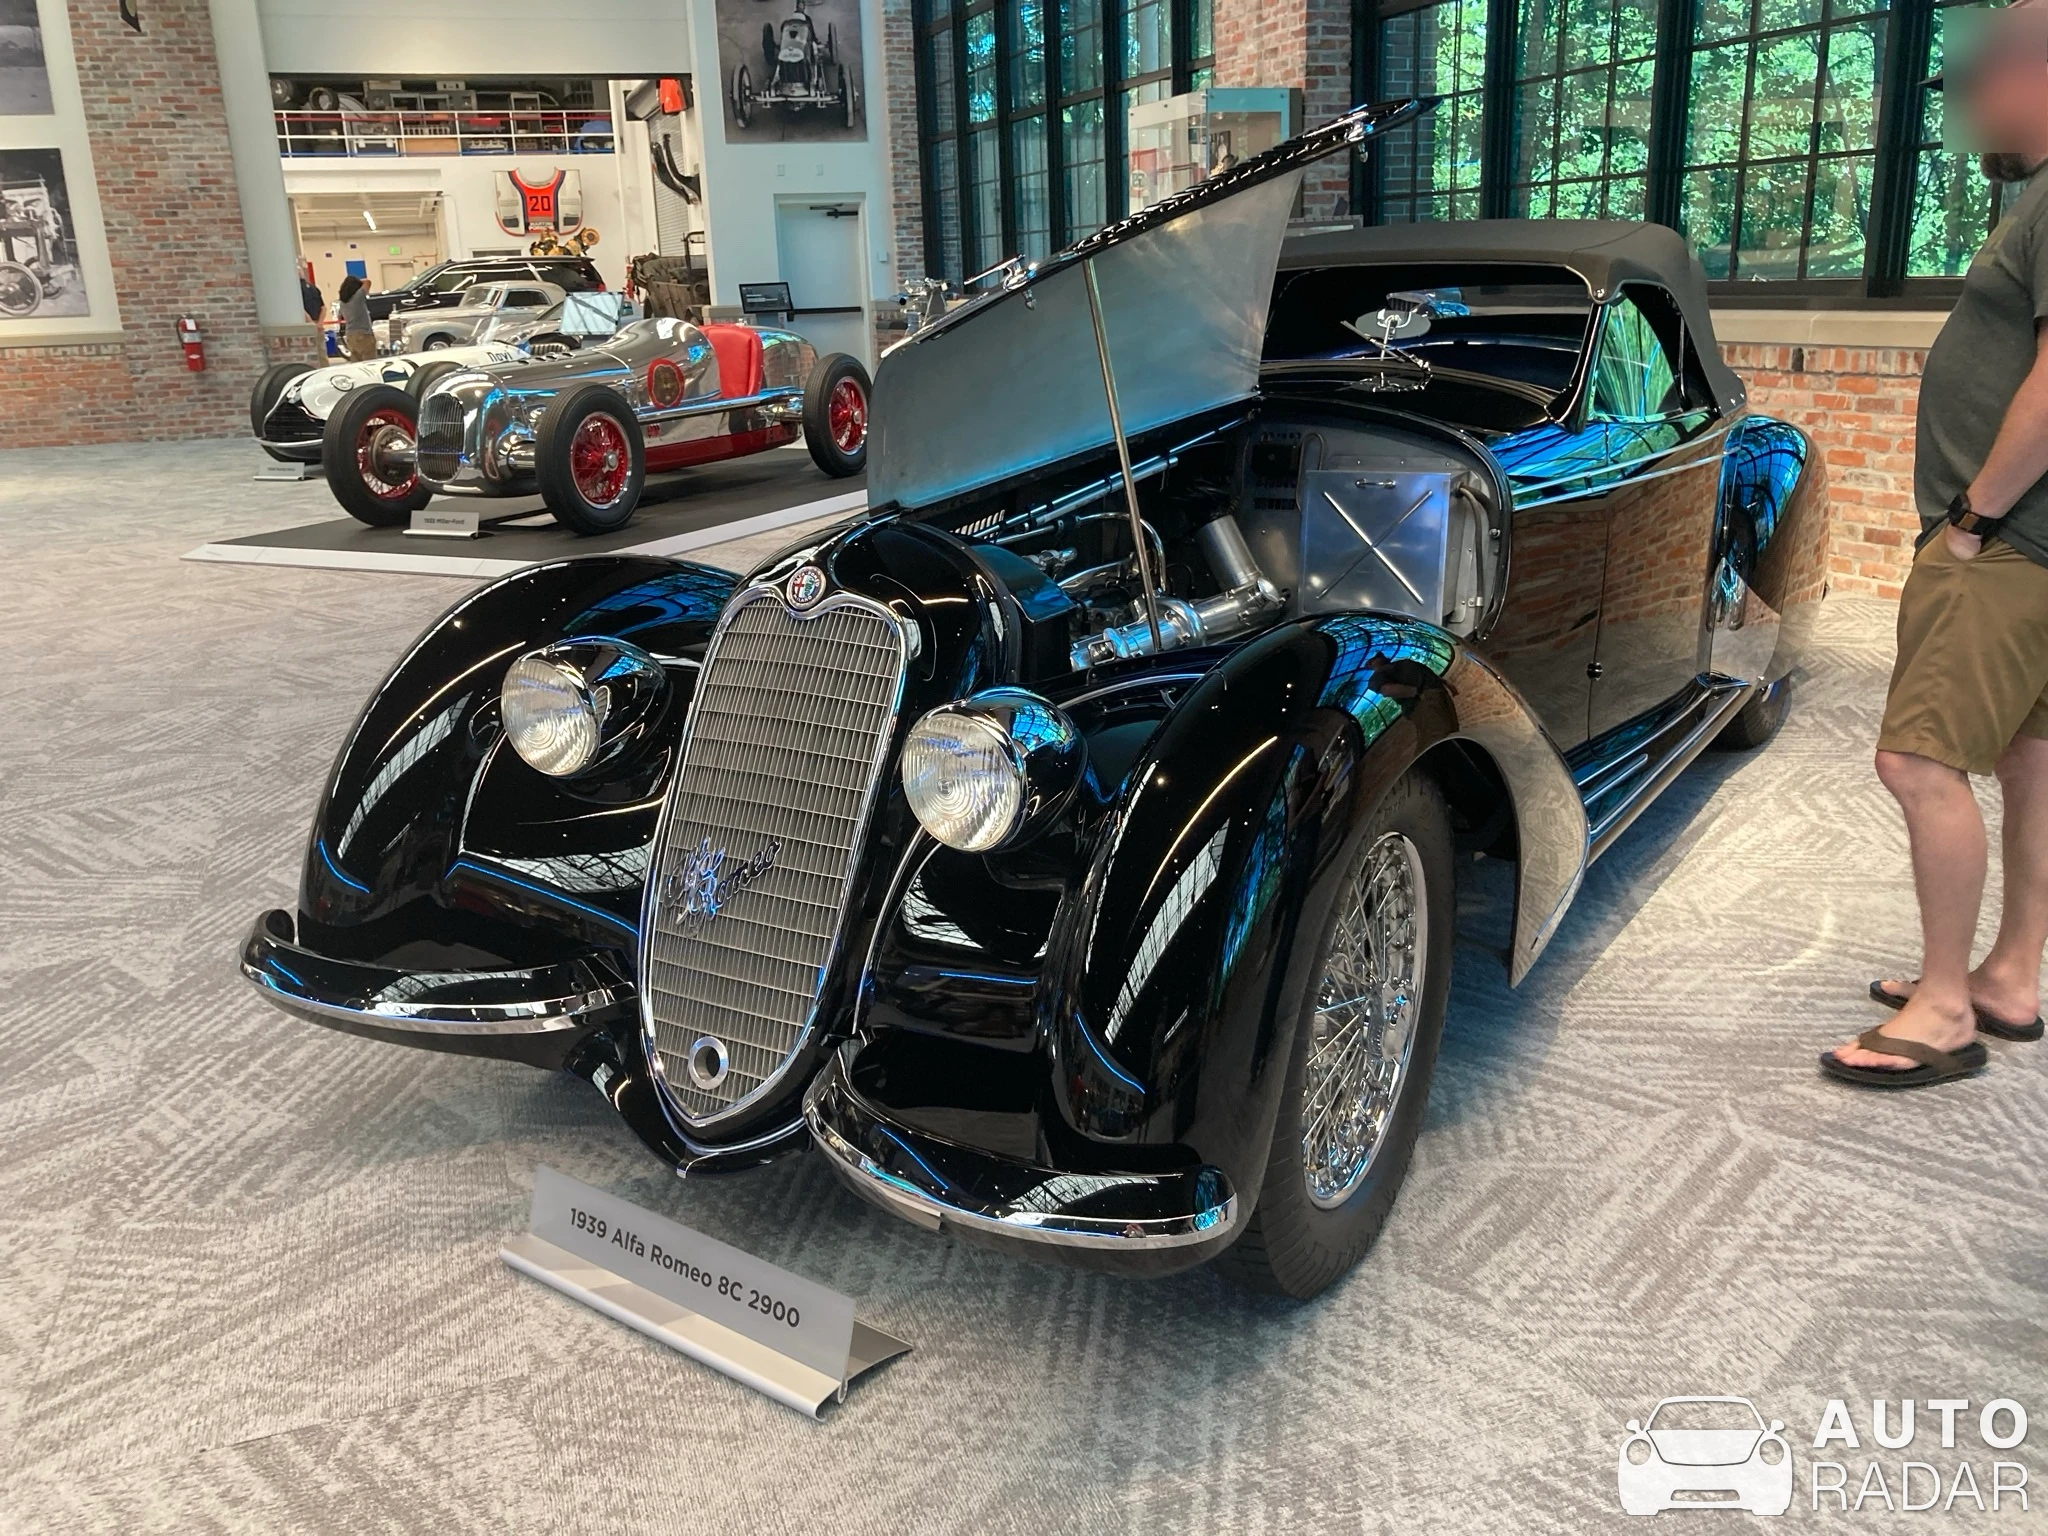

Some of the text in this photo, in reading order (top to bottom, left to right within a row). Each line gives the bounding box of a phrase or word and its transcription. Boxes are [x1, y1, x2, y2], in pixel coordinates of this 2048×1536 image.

[529, 195, 551, 212] 20
[570, 1208, 800, 1328] 1939 Alfa Romeo 8C 2900
